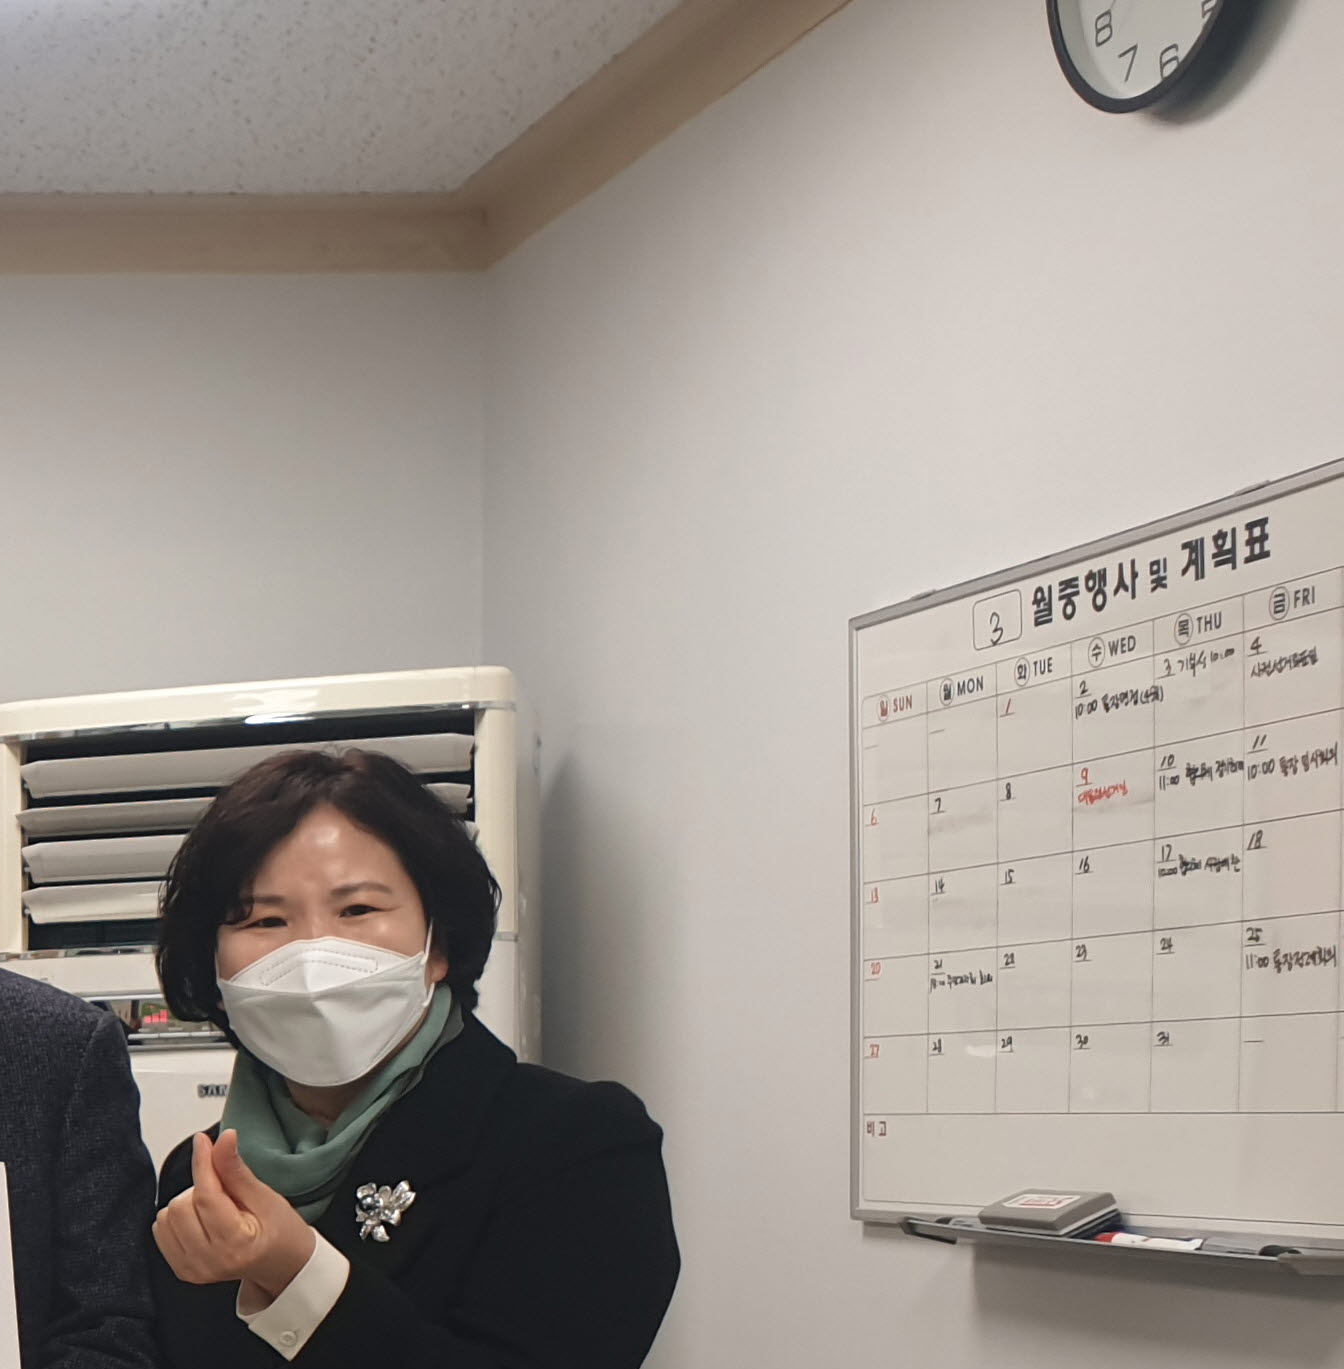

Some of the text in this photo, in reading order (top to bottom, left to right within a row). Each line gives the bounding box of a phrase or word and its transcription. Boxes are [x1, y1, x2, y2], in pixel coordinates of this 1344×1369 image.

[1095, 9, 1113, 47] 8
[1118, 44, 1138, 82] 7
[1159, 43, 1179, 78] 6
[1032, 517, 1270, 626] 월중행사 및 계획표
[1294, 586, 1315, 608] FRI
[990, 612, 1004, 646] 3
[1197, 612, 1222, 634] THU
[1108, 635, 1136, 657] WED
[1251, 636, 1262, 655] 4
[1033, 657, 1053, 677] TUE
[957, 676, 984, 697] MON
[1079, 680, 1088, 695] 2
[892, 695, 912, 713] SUN
[1252, 735, 1267, 749] 11
[1160, 754, 1175, 768] 10
[1247, 758, 1275, 781] 10:00
[1081, 767, 1089, 785] 9
[1005, 782, 1012, 800] 8
[934, 798, 941, 812] 7
[870, 808, 878, 825] 6
[1247, 830, 1263, 850] 18
[1161, 844, 1172, 861] 17
[1079, 856, 1090, 873] 16
[934, 878, 945, 893] 14
[1005, 869, 1015, 884] 15
[1246, 927, 1263, 942] 25
[1001, 1036, 1013, 1052] 29
